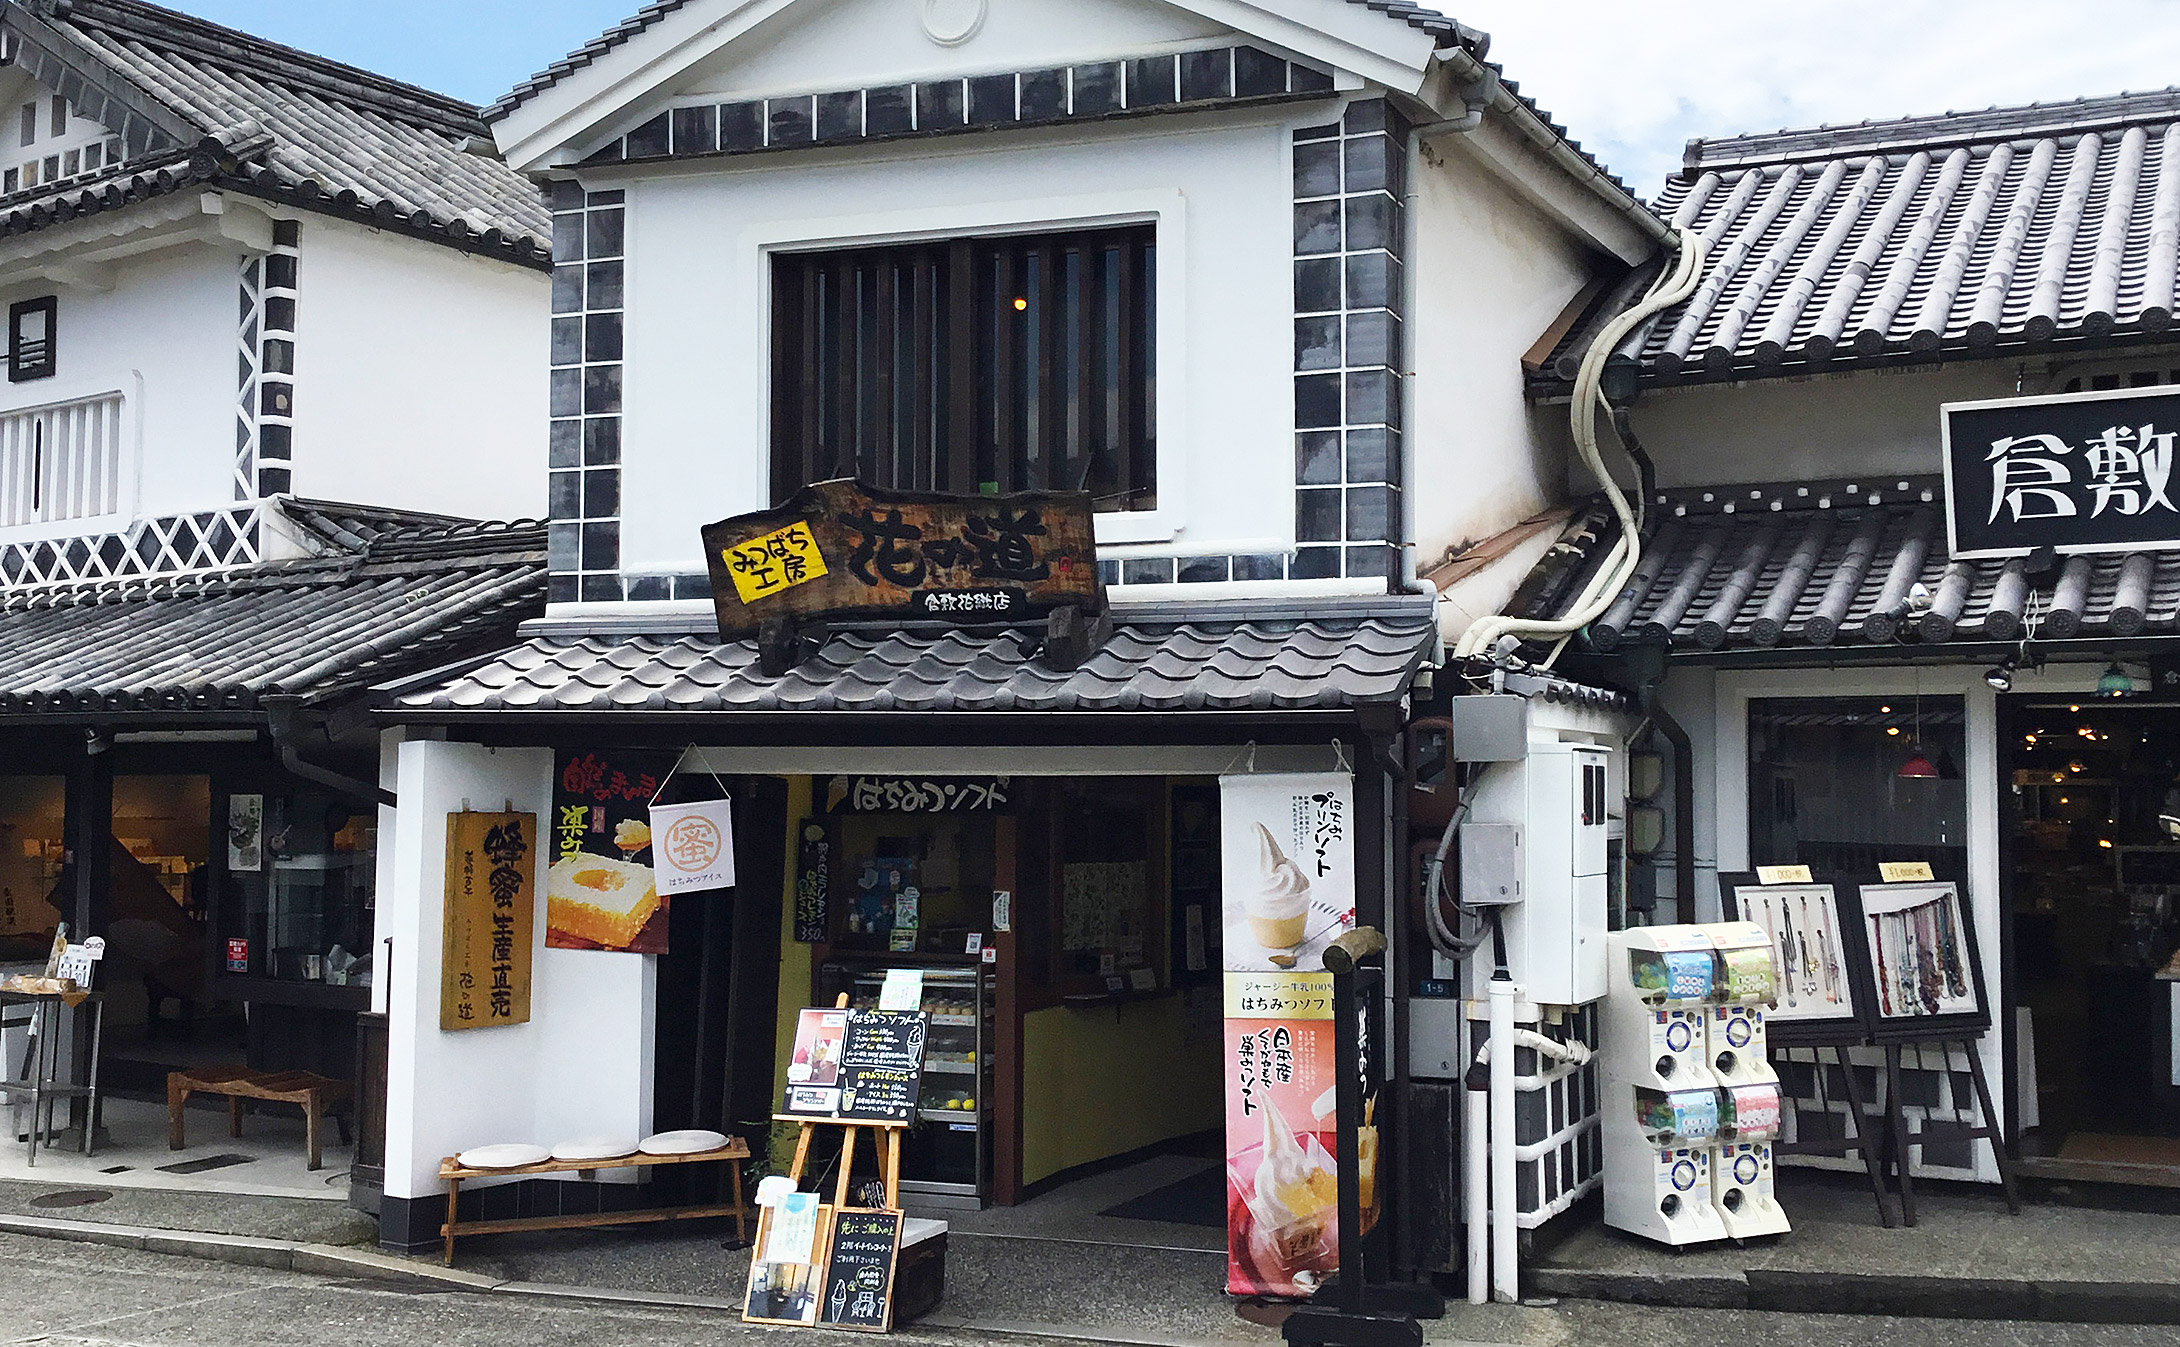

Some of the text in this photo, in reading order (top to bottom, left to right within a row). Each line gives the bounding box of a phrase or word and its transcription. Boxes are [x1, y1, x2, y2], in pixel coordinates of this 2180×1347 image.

[1984, 423, 2180, 525] 倉敷
[732, 528, 810, 573] みつばち
[838, 508, 1051, 587] 花の道
[753, 556, 809, 592] 工房
[852, 777, 1008, 813] はちみつソフト
[1311, 791, 1335, 878] プリンソフト
[1328, 799, 1344, 842] はちみつ
[672, 821, 714, 866] 蜜
[668, 872, 723, 887] はちみつアイス
[483, 820, 528, 1018] 蜂蜜生産直売
[1427, 983, 1444, 993] 1-5
[853, 1014, 916, 1026] はちみつソフト
[1237, 1035, 1258, 1116] 巣みつソフト
[1274, 1027, 1293, 1083] 日本産
